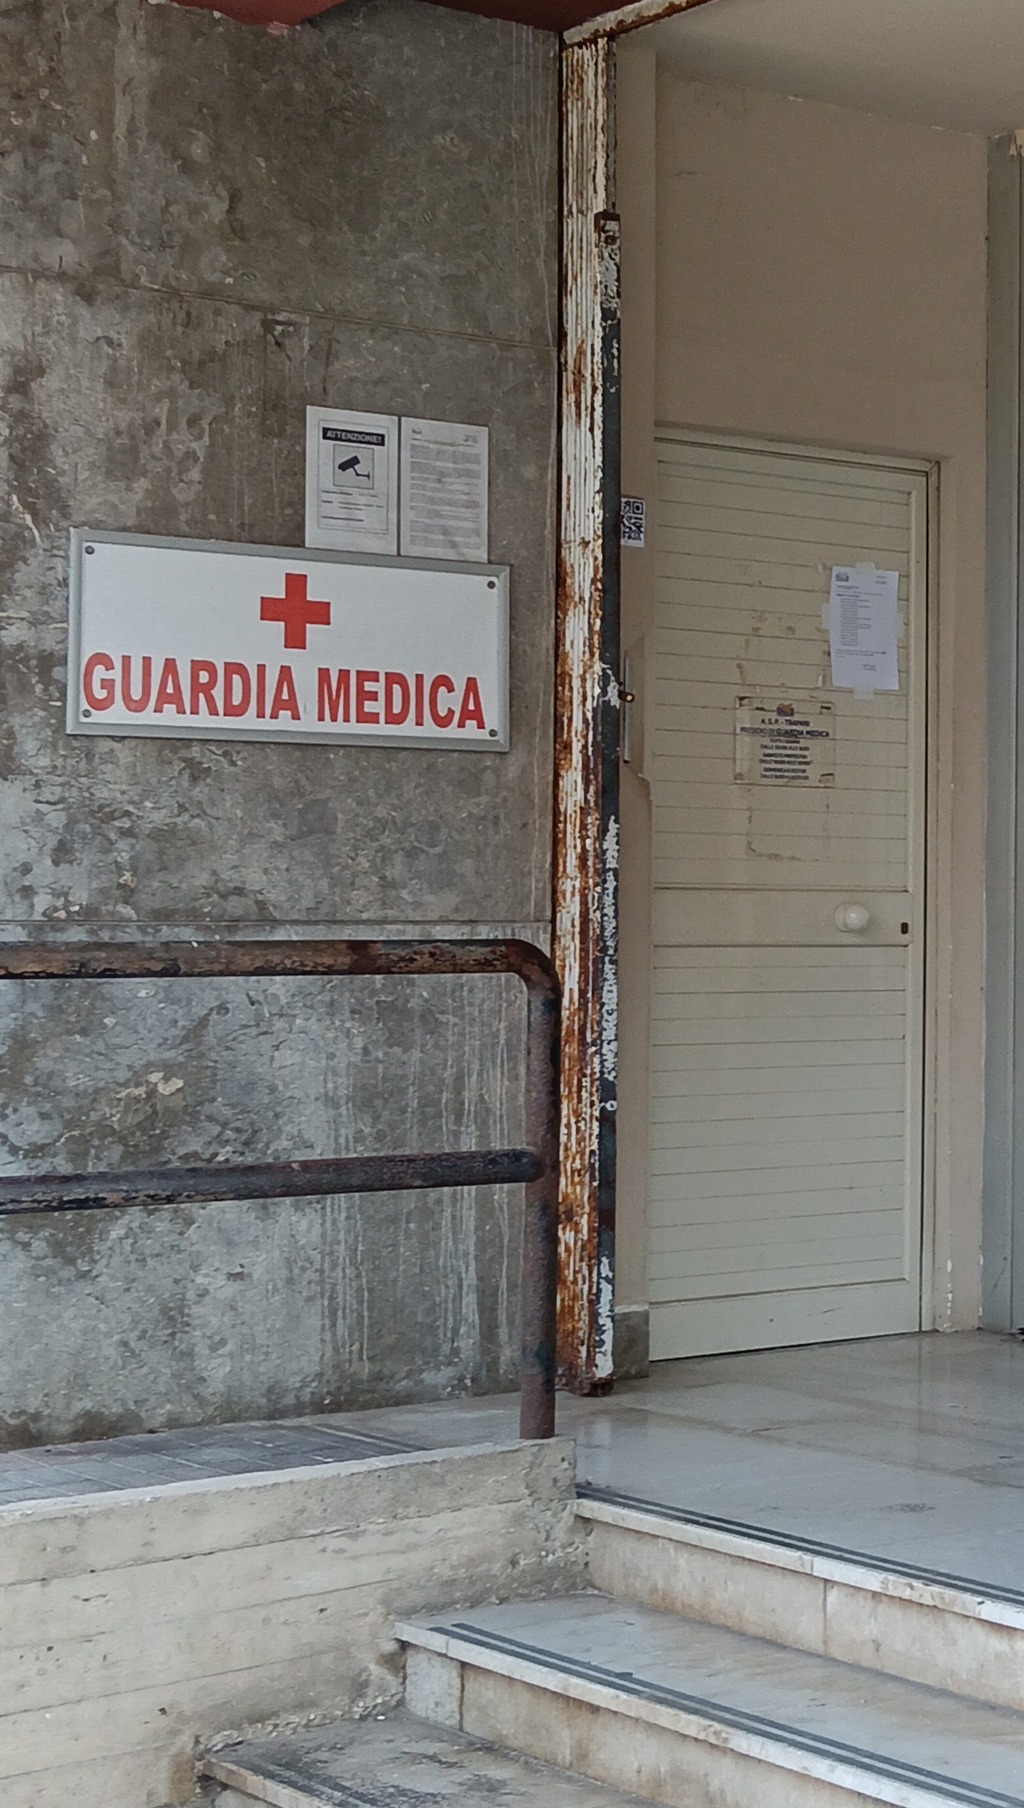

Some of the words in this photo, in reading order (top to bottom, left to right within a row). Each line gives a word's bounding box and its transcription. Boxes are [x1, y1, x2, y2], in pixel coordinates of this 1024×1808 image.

[326, 430, 382, 443] ATTENZIONE!
[83, 652, 301, 721] GUARDIA
[317, 667, 486, 730] MEDICA
